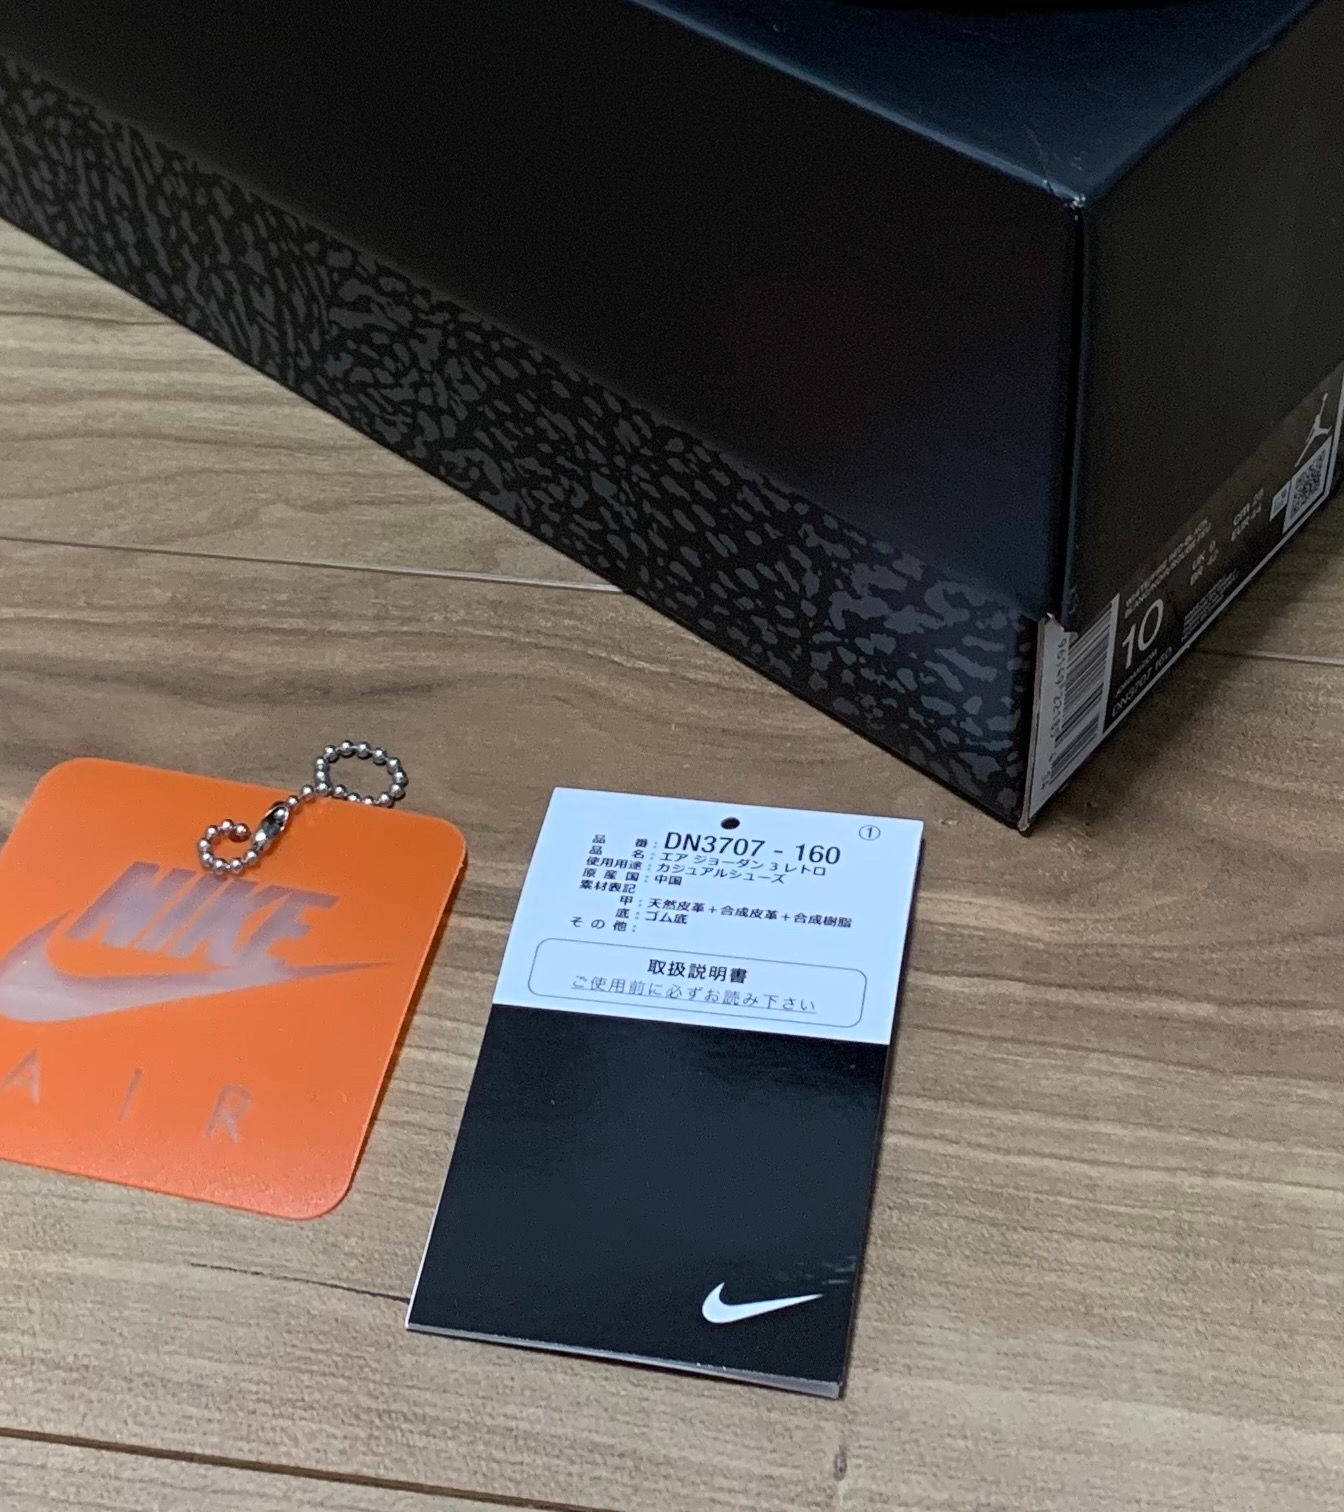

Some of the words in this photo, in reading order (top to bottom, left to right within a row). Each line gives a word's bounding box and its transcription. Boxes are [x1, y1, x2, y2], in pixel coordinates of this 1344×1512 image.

[1122, 598, 1164, 669] 10
[664, 832, 765, 857] DN3707
[795, 843, 841, 865] 160
[654, 874, 683, 886] 中国
[656, 863, 786, 885] カジュアルシューズ
[579, 880, 636, 894] 素材表記
[64, 861, 339, 971] NIKE
[645, 911, 688, 925] ゴム底
[647, 959, 748, 984] 取扱説明書
[572, 975, 816, 1011] ご使用前に必ずお読み下さい
